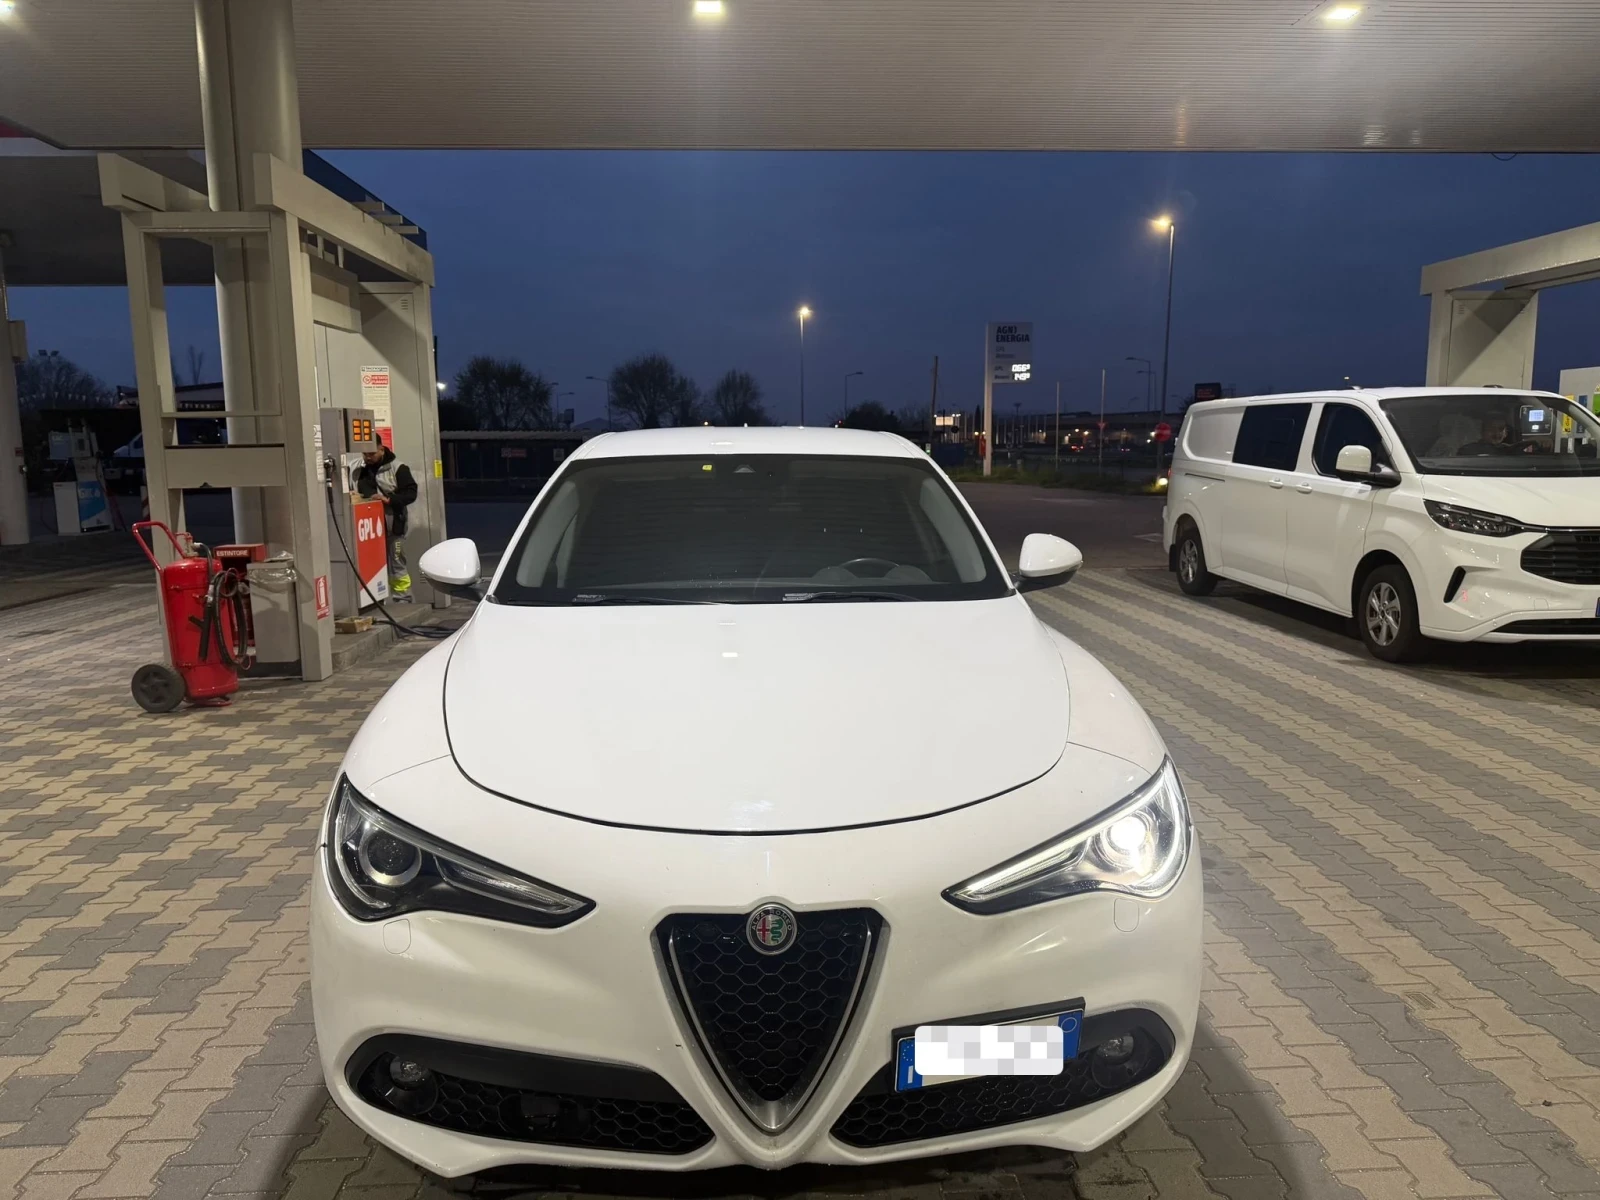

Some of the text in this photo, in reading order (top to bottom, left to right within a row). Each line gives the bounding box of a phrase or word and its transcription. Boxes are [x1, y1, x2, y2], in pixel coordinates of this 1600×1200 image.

[996, 334, 1030, 343] ENERGIA
[358, 517, 375, 542] GPL
[216, 549, 248, 557] ESTINTORE
[752, 910, 792, 930] ALFA ROMEO
